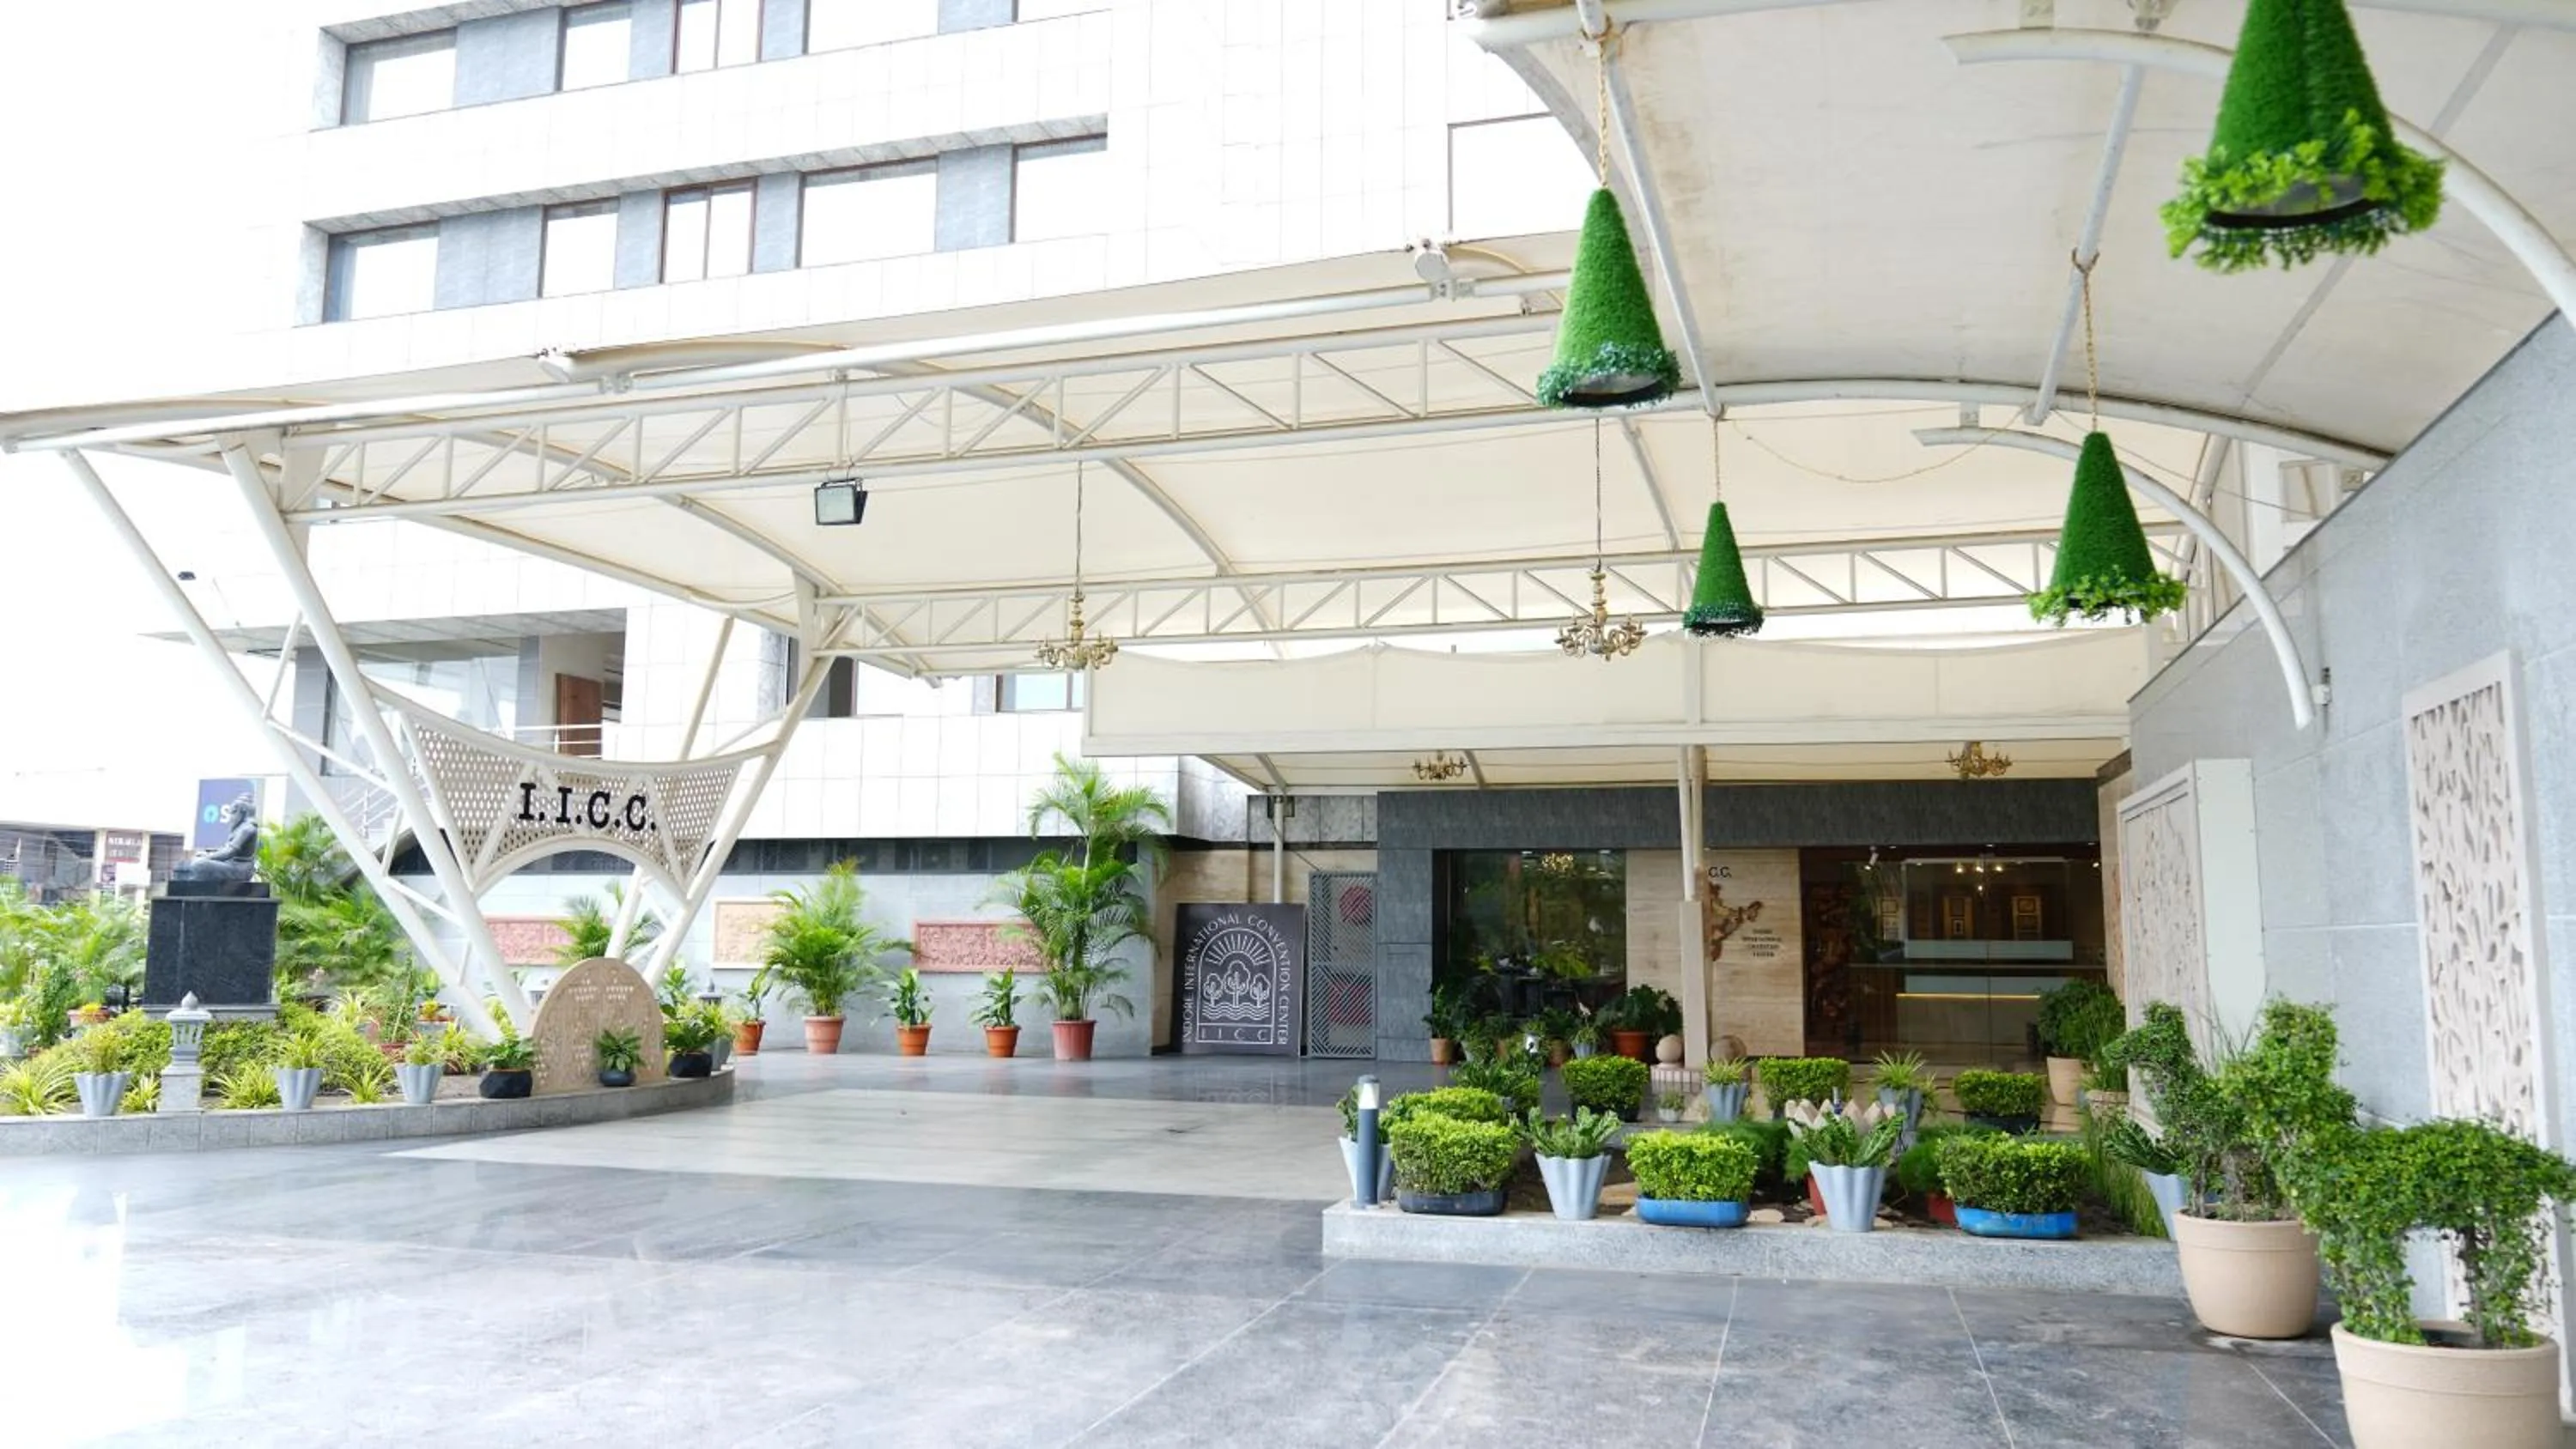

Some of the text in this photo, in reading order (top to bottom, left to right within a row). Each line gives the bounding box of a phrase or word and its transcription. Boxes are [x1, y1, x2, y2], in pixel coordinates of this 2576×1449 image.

[518, 782, 657, 832] I.I.C.C.
[1184, 912, 1241, 990] INTERNATIONAL
[1248, 914, 1291, 991] CONVENTION
[1277, 995, 1290, 1045] CENTER
